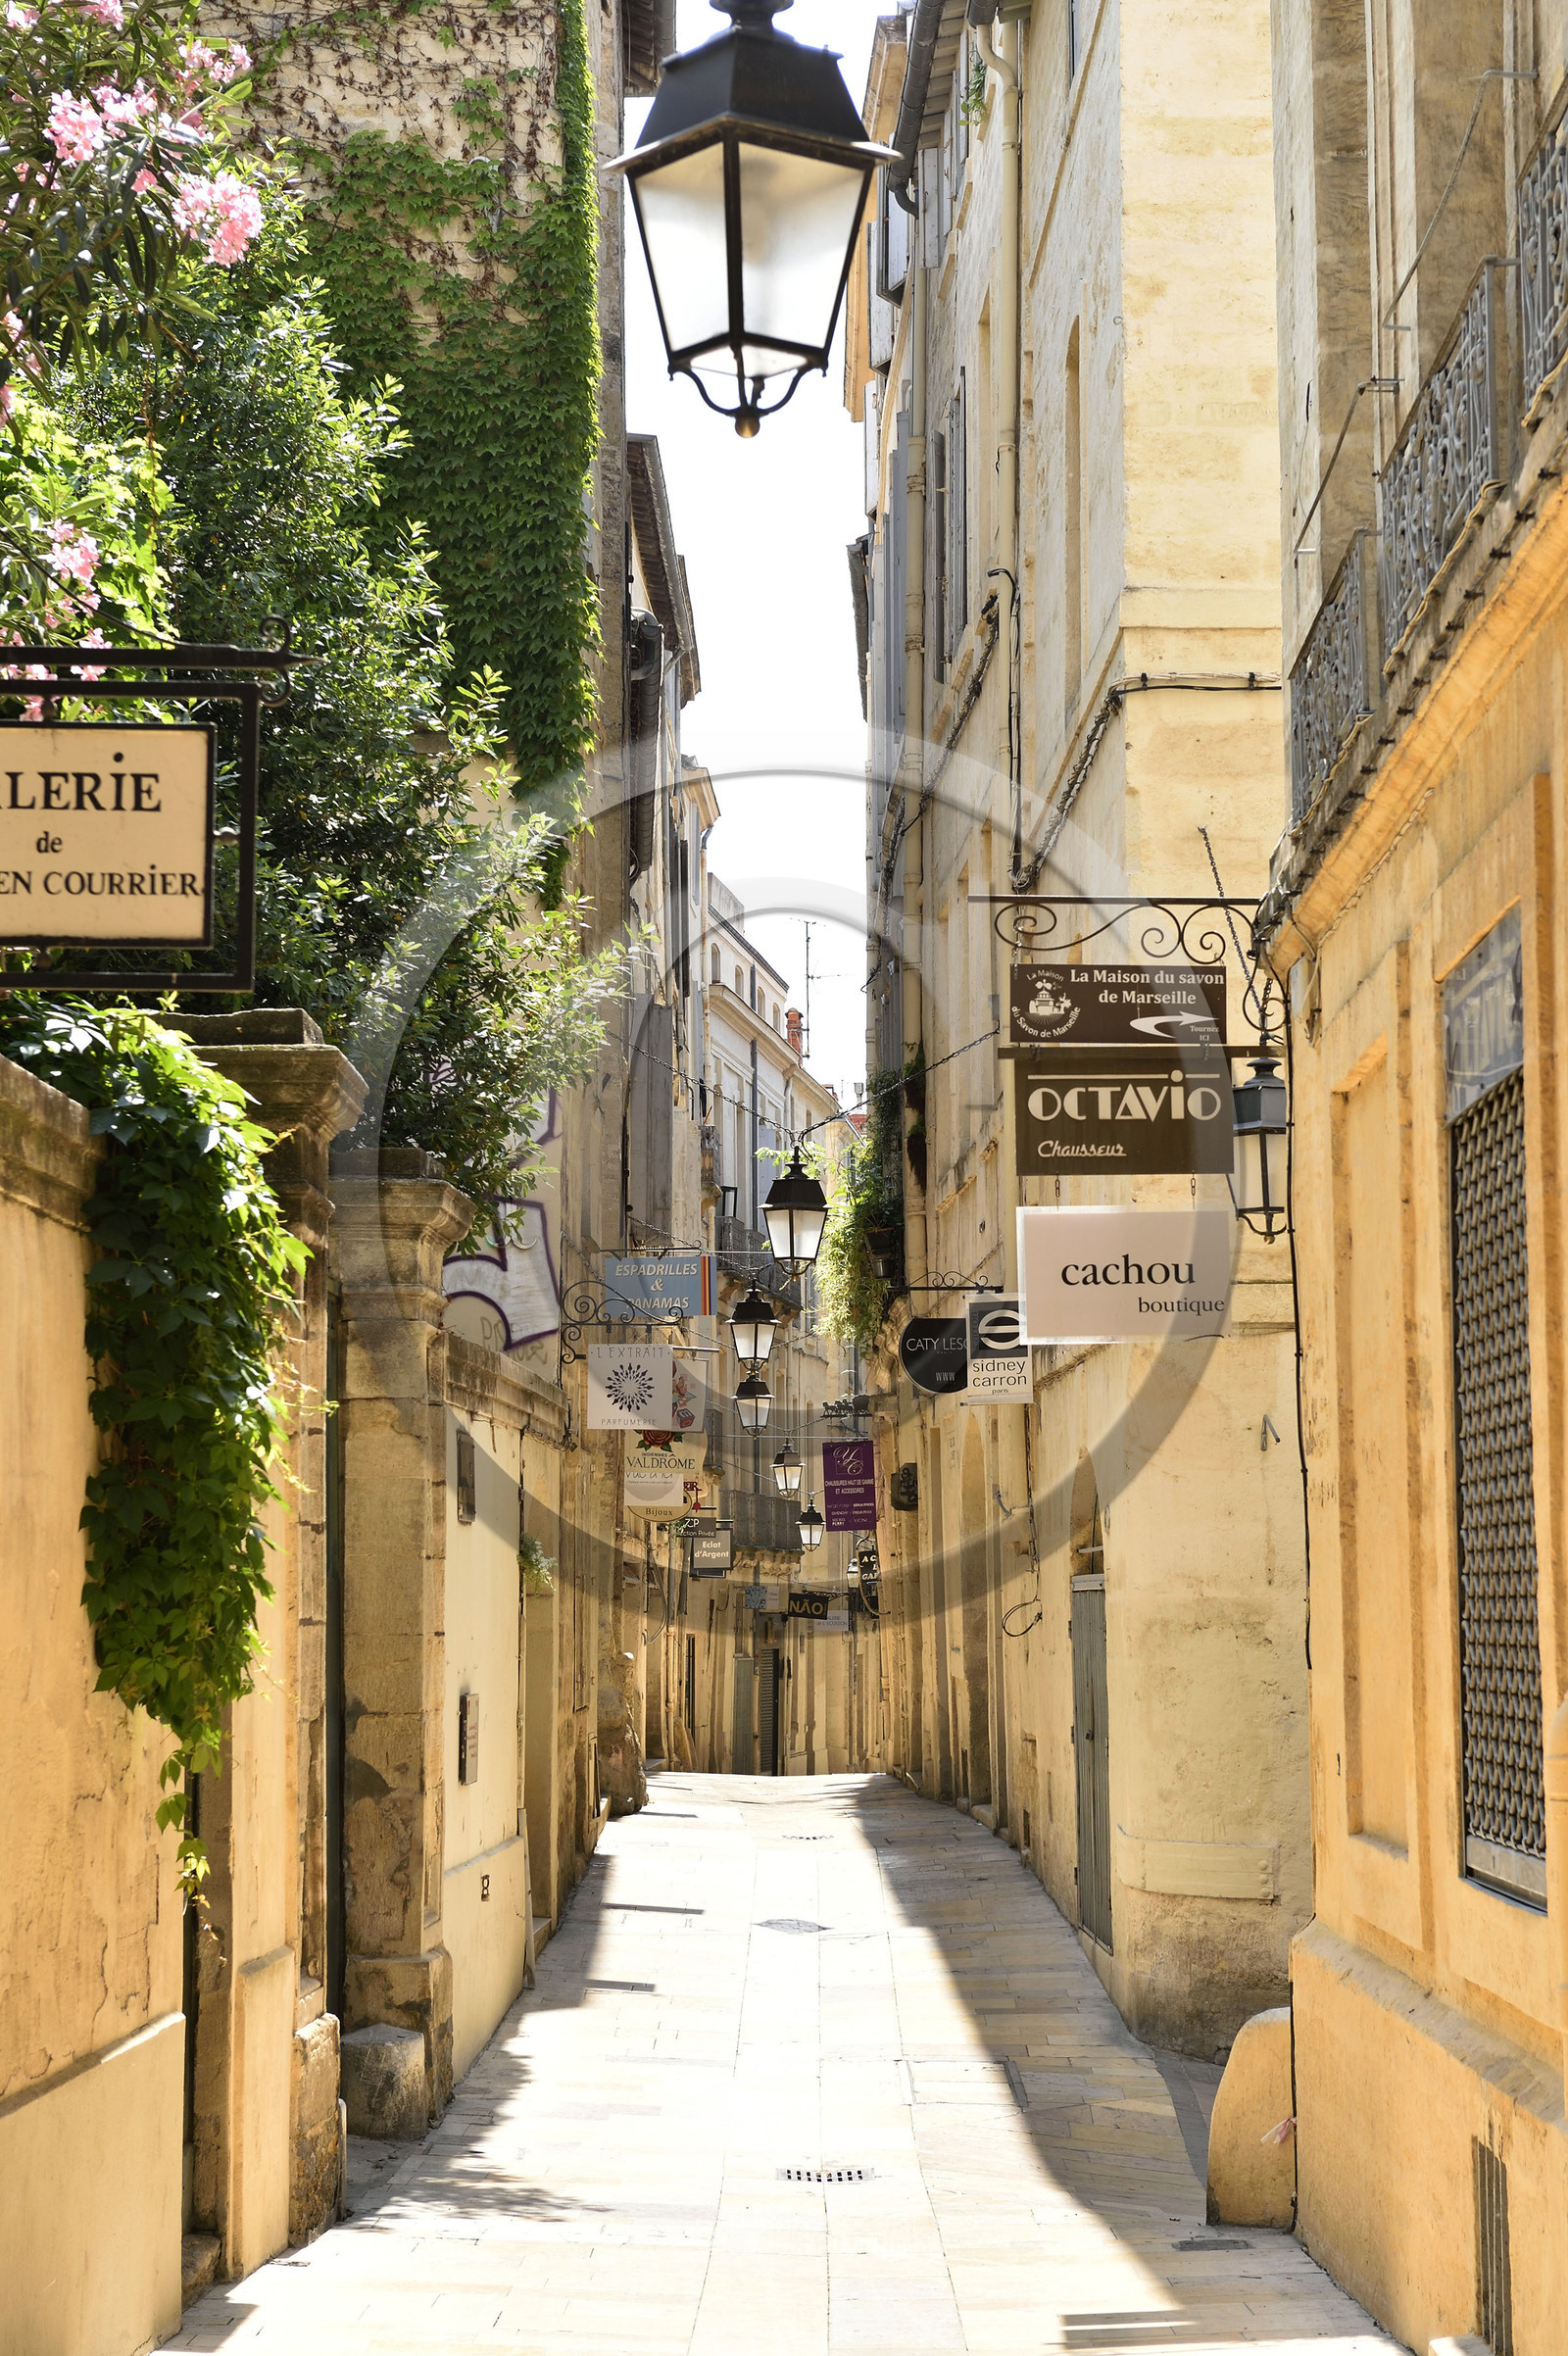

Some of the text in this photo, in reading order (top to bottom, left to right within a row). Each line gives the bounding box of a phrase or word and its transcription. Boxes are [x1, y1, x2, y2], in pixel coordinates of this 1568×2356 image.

[36, 831, 63, 854] de
[1037, 969, 1064, 982] Maison
[1070, 969, 1224, 985] La Maison du savon
[1099, 990, 1197, 1005] de Marseille
[1011, 1006, 1081, 1038] du Savon de Marseille
[1037, 1139, 1127, 1158] Chausseur
[614, 1263, 699, 1277] ESPADRILLES
[1060, 1254, 1196, 1287] cachou
[650, 1277, 664, 1293] &
[625, 1297, 690, 1310] PANAMAS
[1138, 1297, 1225, 1316] boutique
[906, 1338, 940, 1351] CATY
[972, 1359, 1026, 1374] sidney
[935, 1372, 956, 1382] WWW
[972, 1375, 1027, 1388] carron
[626, 1453, 696, 1470] VALDRÔME
[645, 1507, 673, 1517] Bijoux
[694, 1550, 729, 1559] d'Argent
[789, 1598, 823, 1615] NÃO
